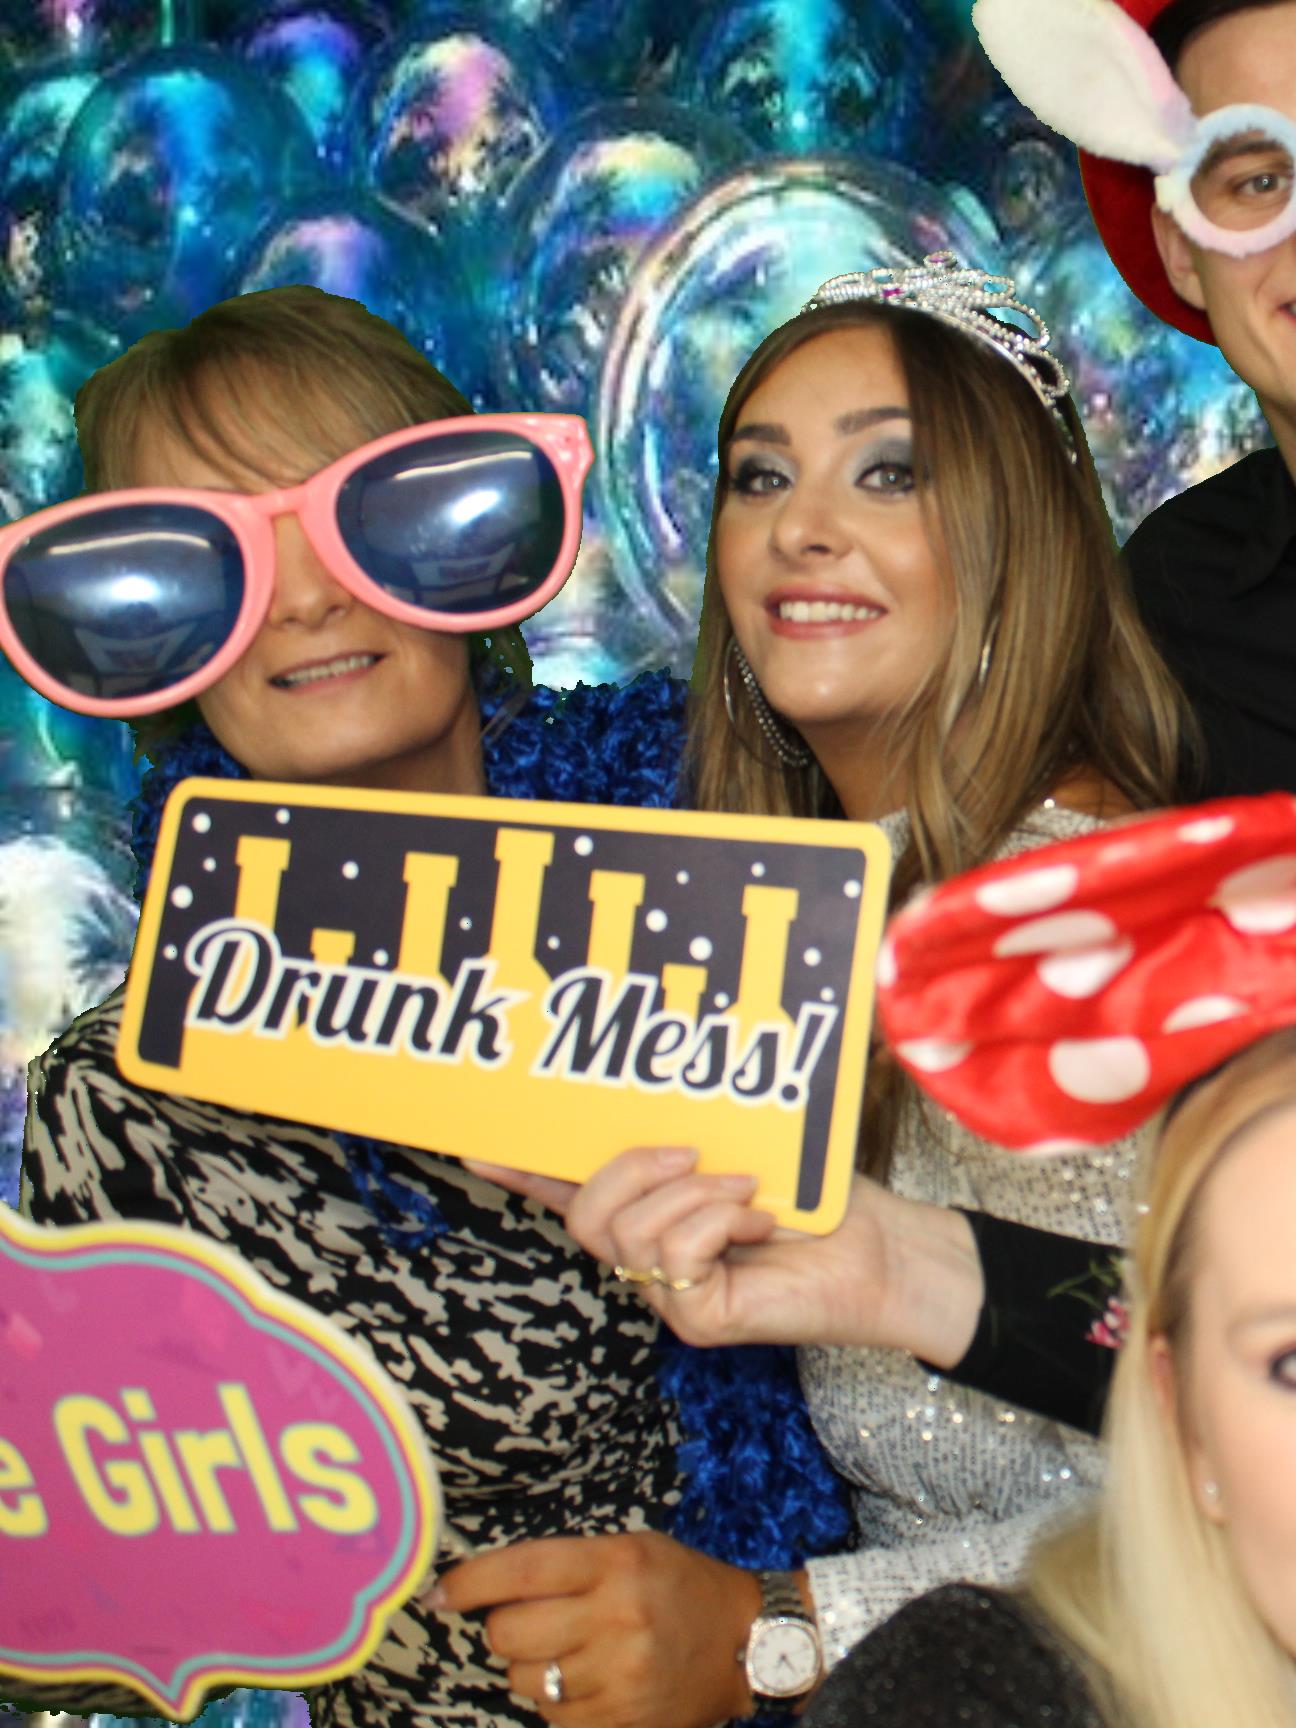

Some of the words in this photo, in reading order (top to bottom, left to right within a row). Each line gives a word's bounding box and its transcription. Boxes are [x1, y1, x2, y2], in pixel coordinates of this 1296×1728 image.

[188, 921, 513, 1065] Drunk
[537, 971, 835, 1107] Mess!
[53, 1382, 378, 1536] Girls
